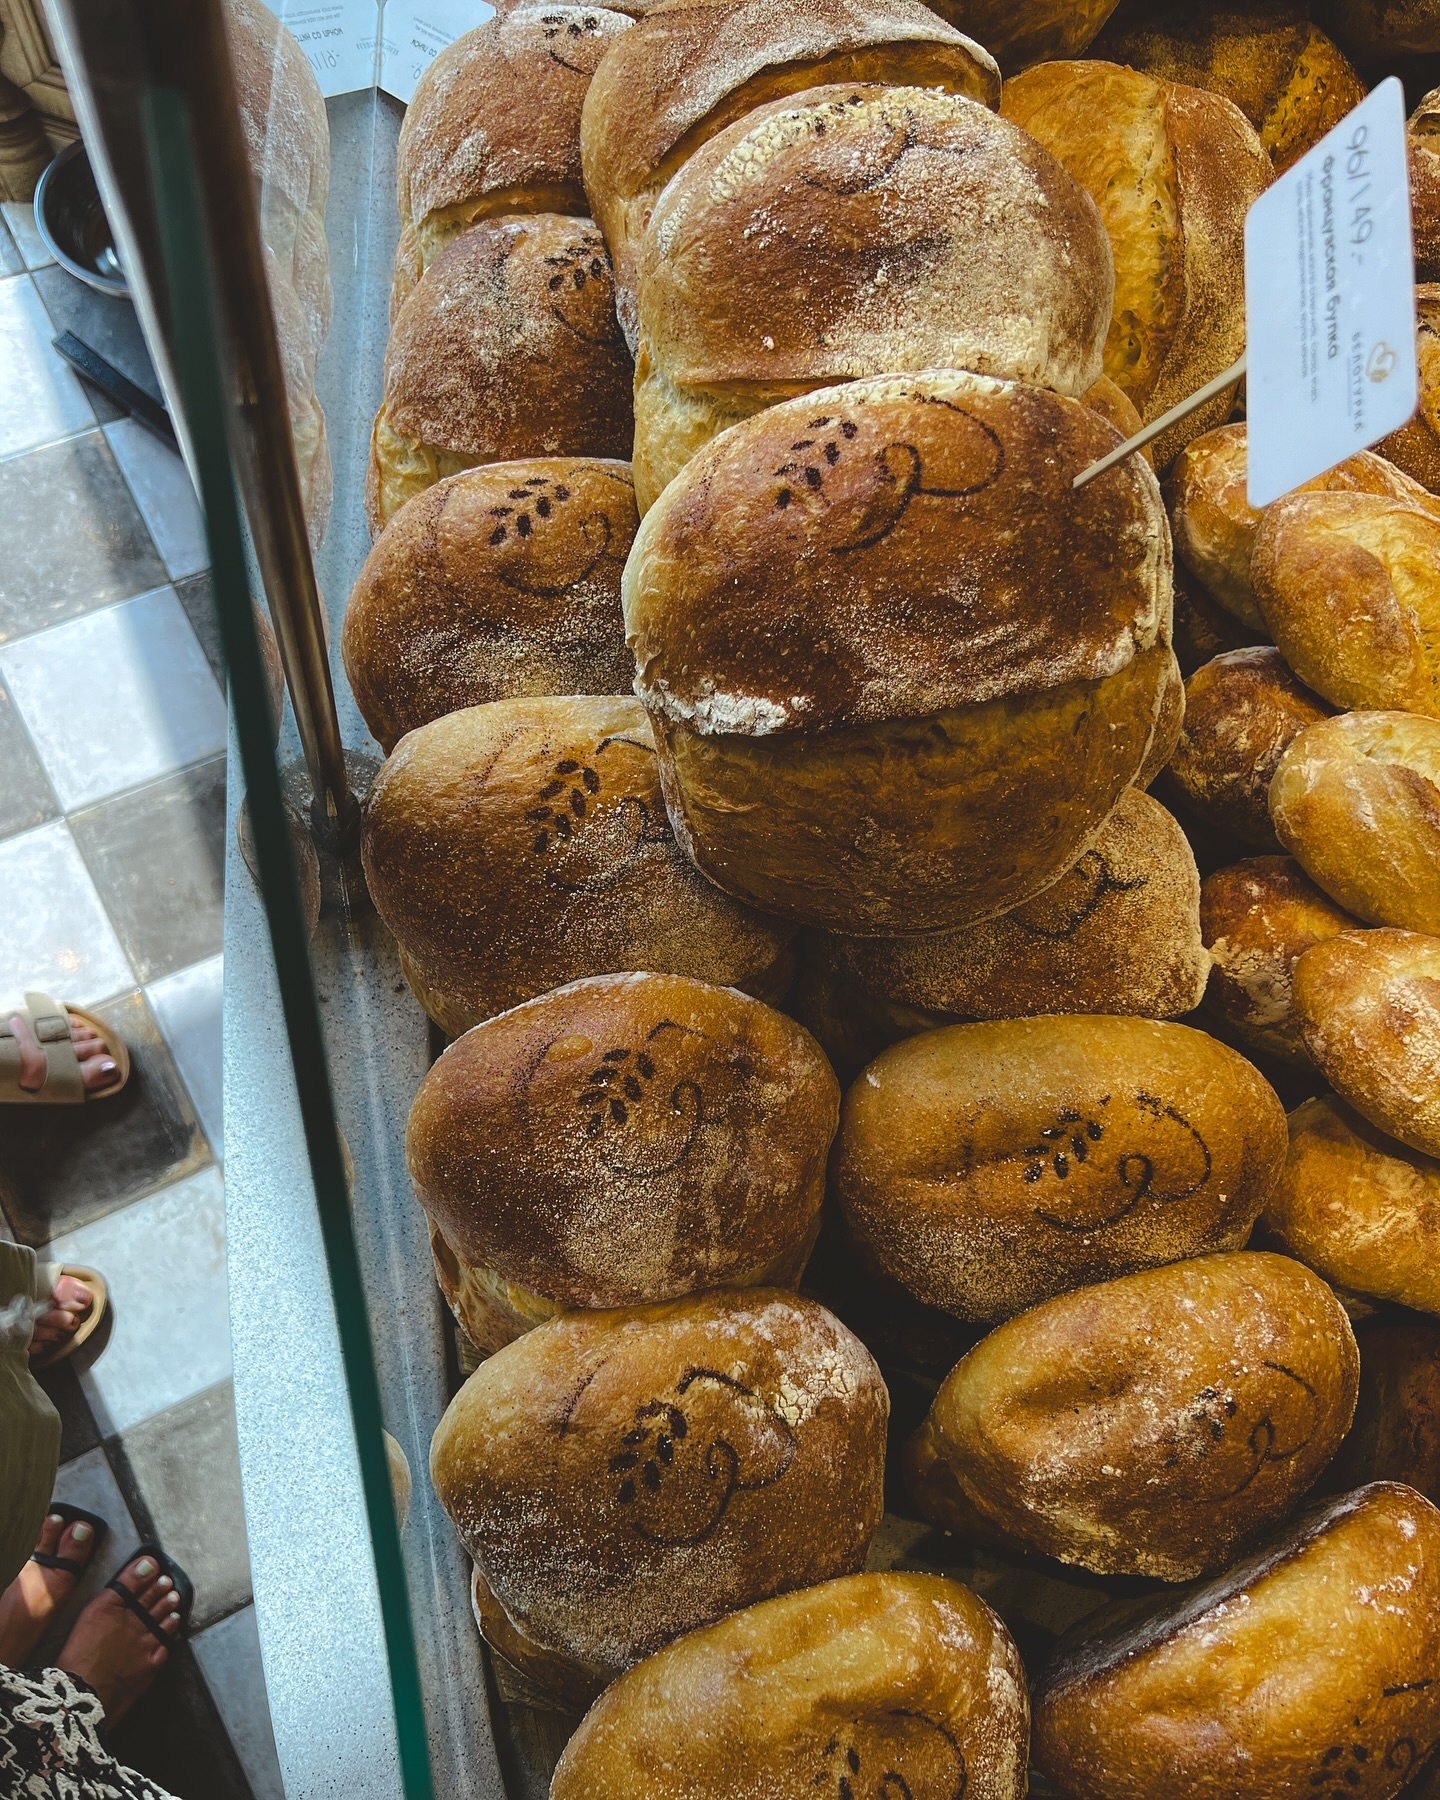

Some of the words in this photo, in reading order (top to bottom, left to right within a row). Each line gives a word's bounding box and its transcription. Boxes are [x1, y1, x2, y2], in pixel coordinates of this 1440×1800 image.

[1320, 154, 1336, 293] Французская
[1324, 294, 1341, 360] булка
[1351, 330, 1364, 433] БЕЛОТУРКА
